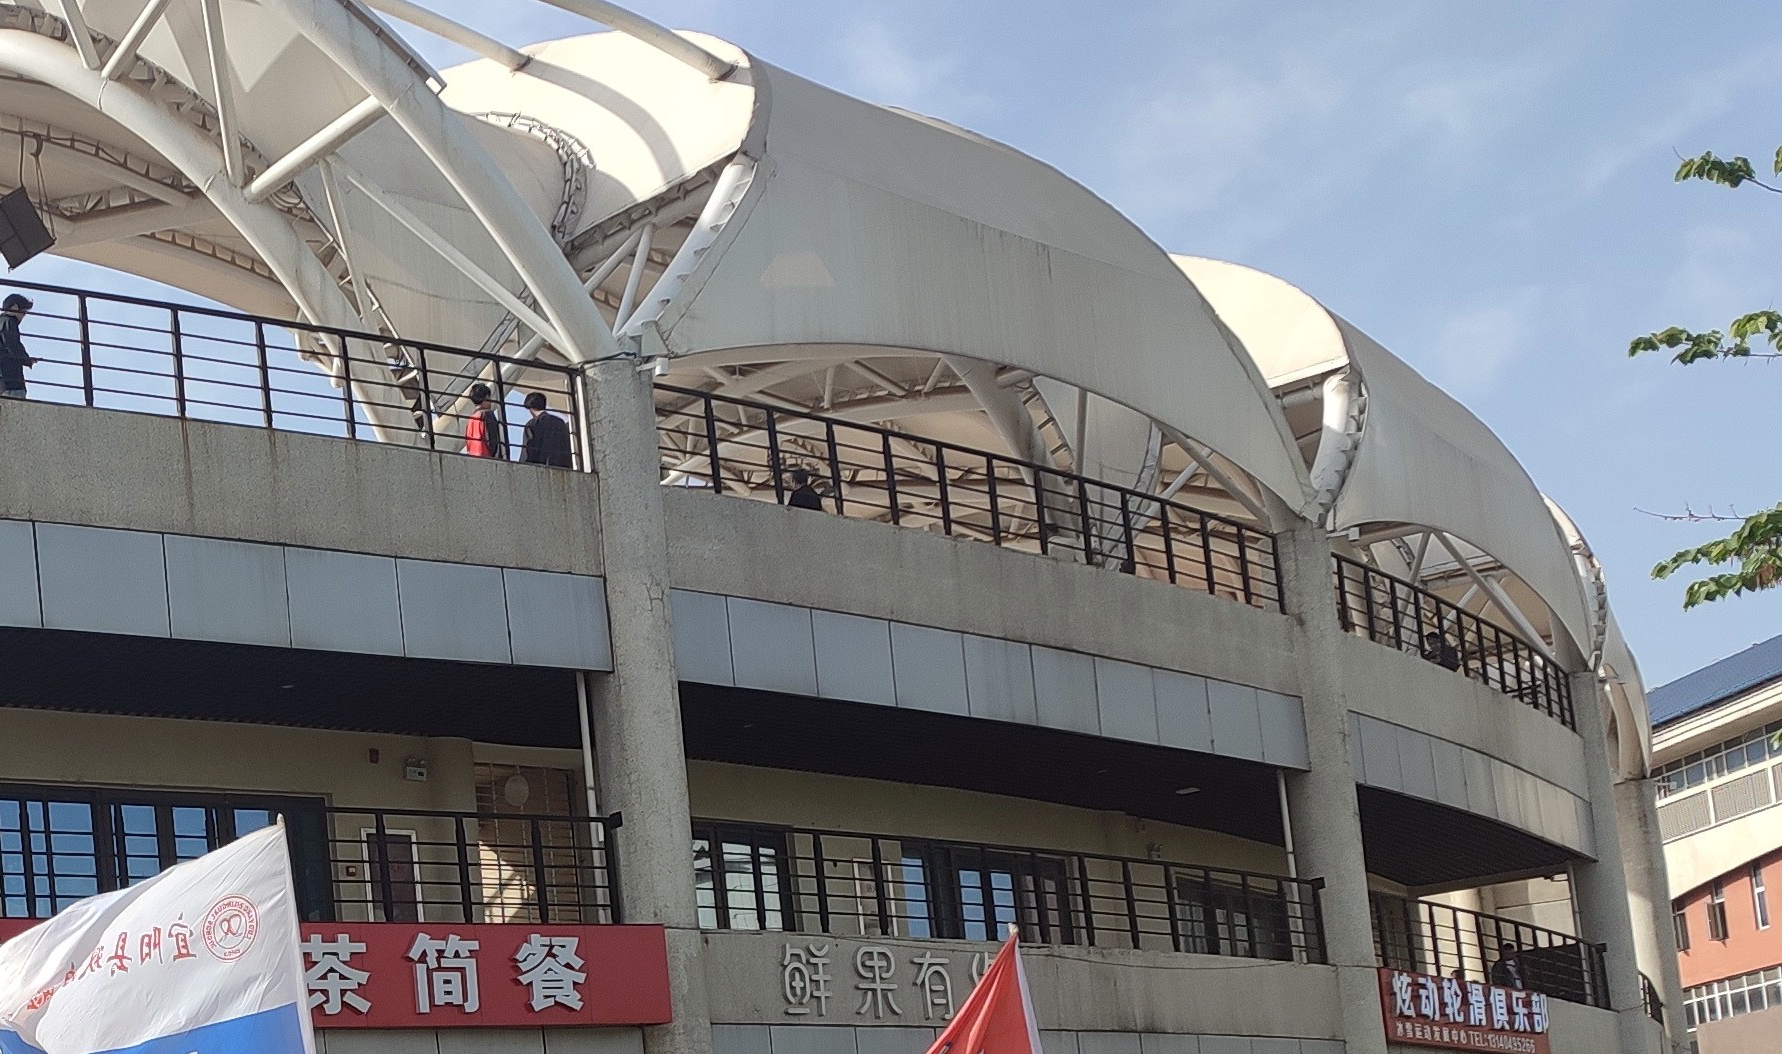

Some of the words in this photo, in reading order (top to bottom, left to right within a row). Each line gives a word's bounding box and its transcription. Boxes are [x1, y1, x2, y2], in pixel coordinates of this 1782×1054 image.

[1391, 970, 1550, 1033] 炫动轮滑俱乐部
